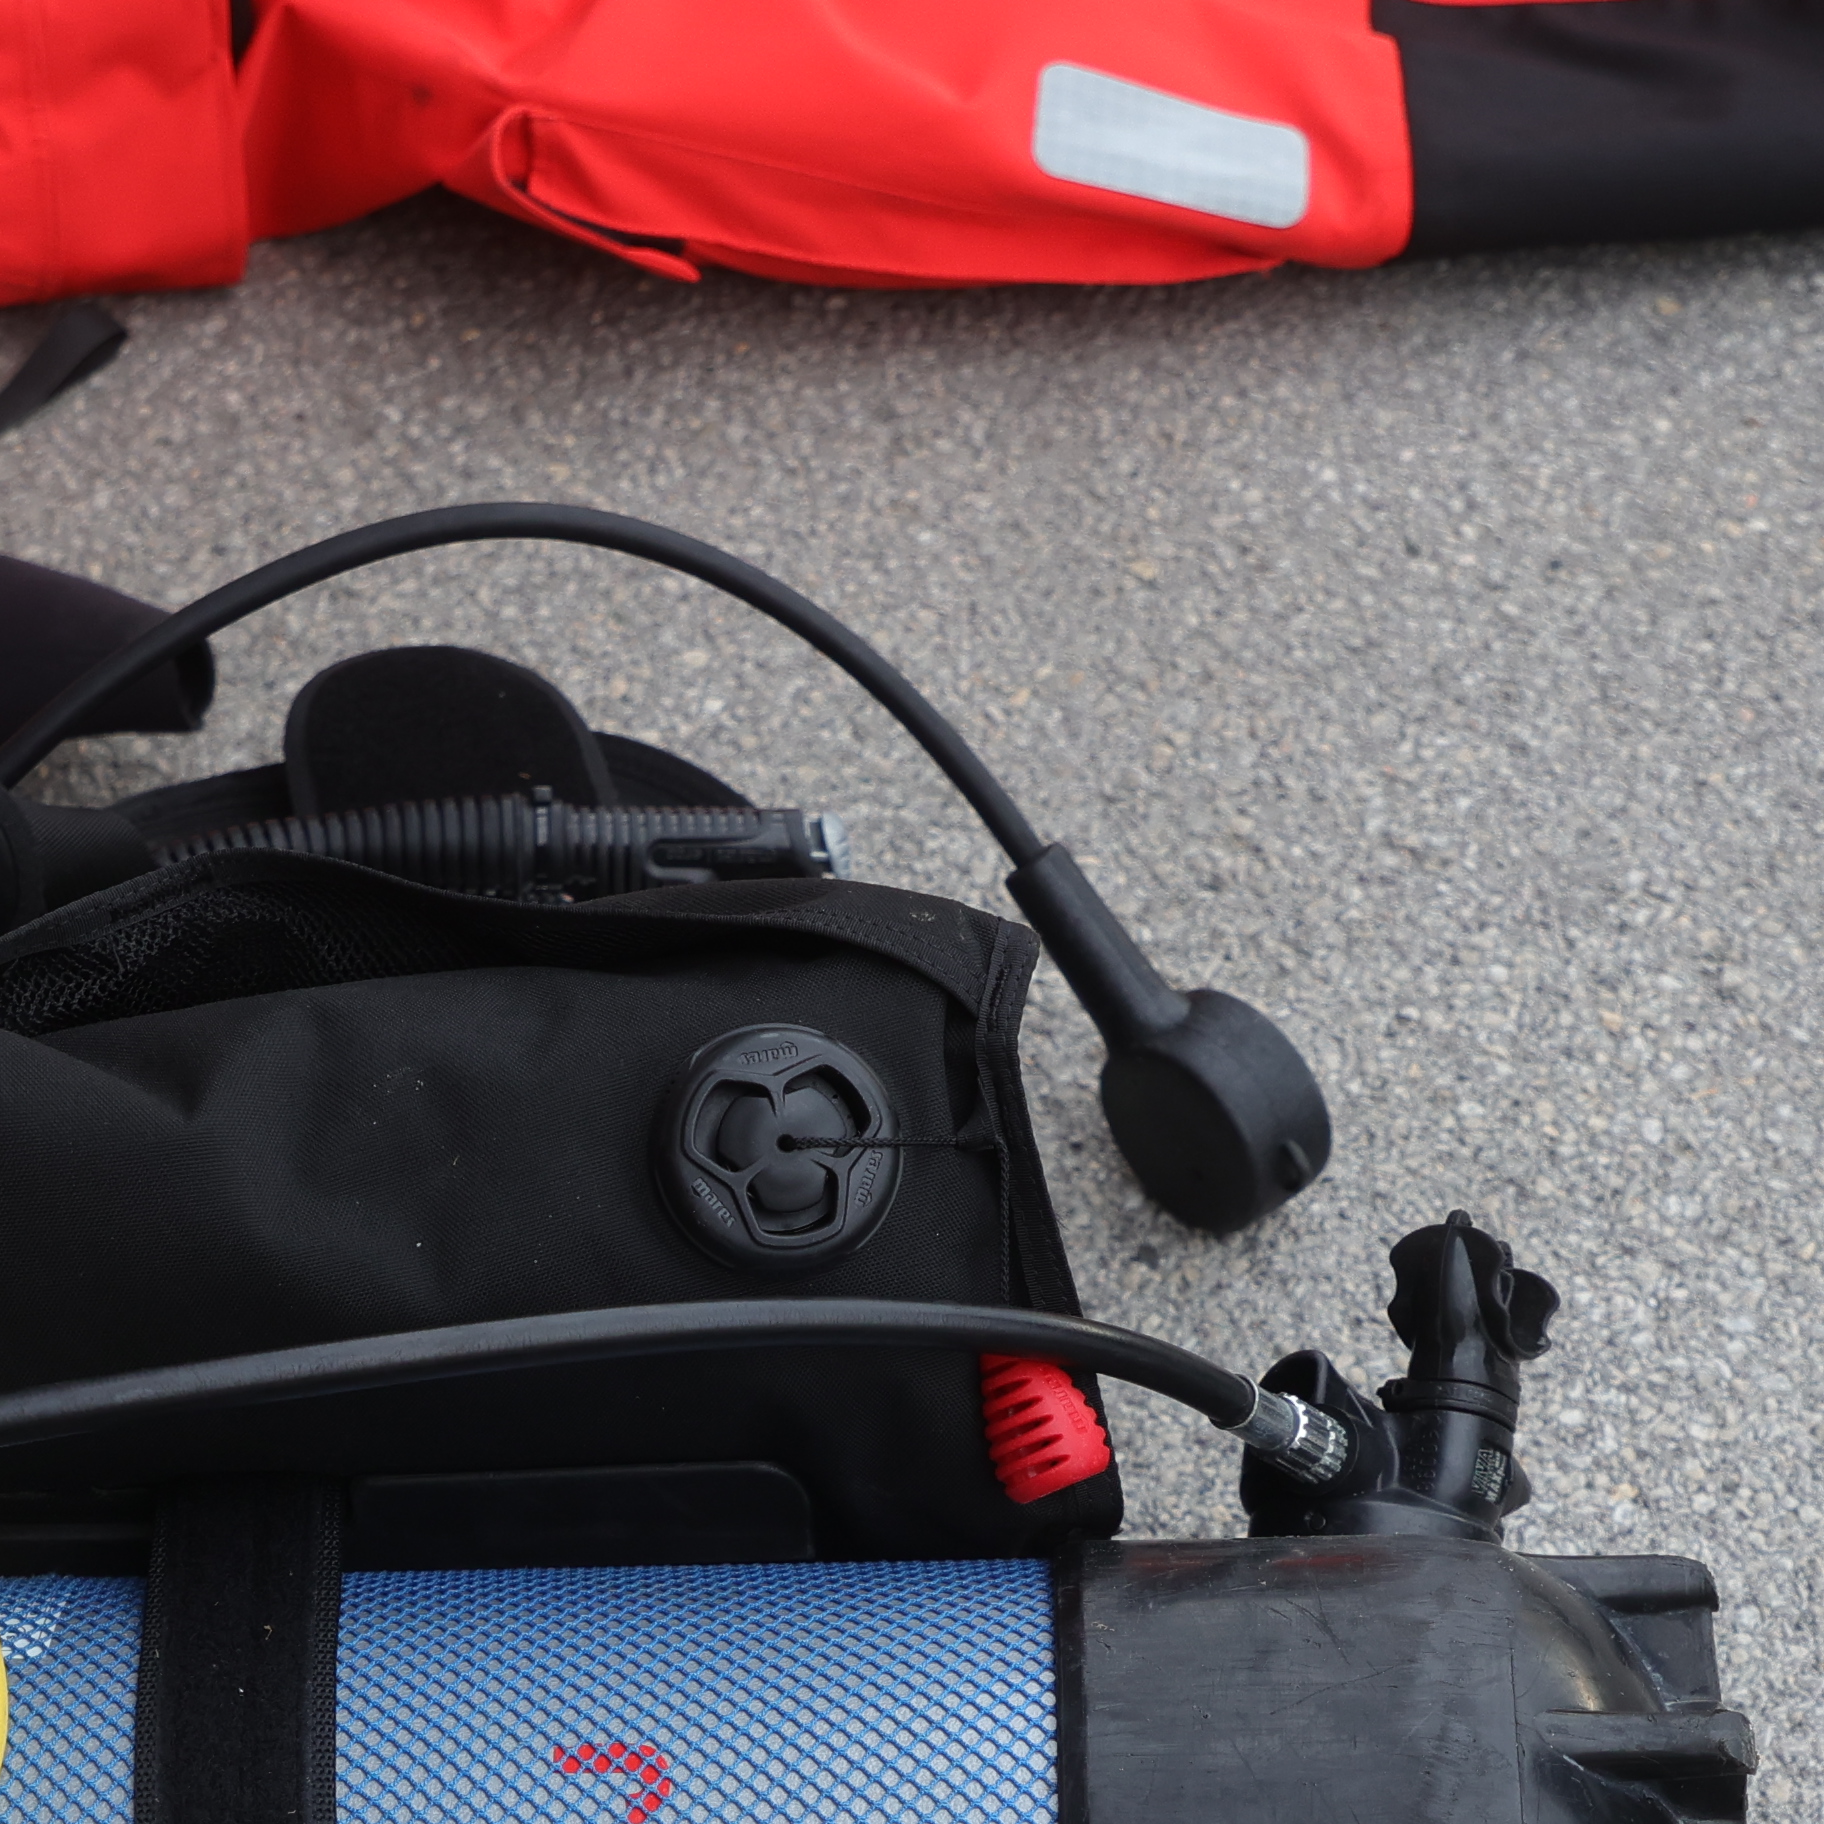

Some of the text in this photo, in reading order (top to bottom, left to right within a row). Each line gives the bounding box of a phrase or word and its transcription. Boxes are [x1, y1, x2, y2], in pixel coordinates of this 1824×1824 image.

[738, 1040, 800, 1066] mares
[690, 1176, 735, 1230] mares
[855, 1150, 883, 1208] mares
